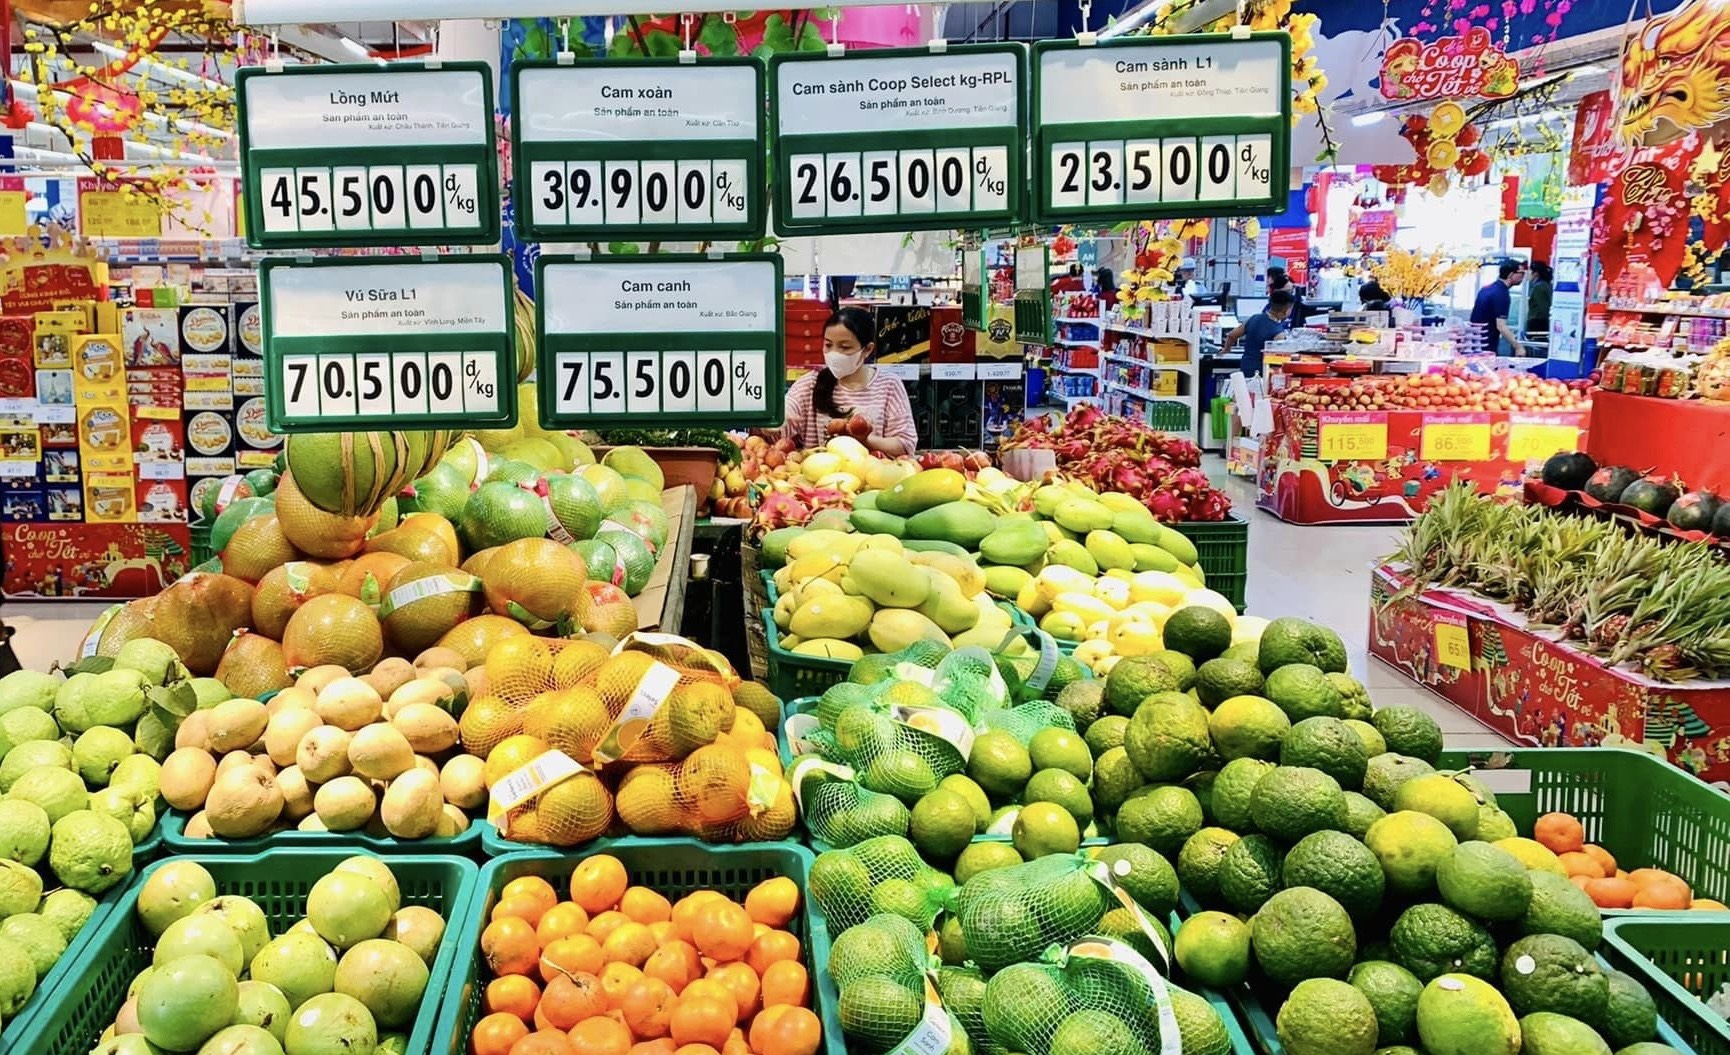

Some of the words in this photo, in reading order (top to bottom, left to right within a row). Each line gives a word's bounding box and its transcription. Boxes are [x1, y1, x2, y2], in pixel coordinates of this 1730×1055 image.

[1115, 60, 1148, 73] Cam
[1152, 57, 1187, 72] sành
[1196, 56, 1213, 69] L1
[792, 82, 825, 97] Cam
[829, 79, 864, 94] sành
[868, 77, 908, 93] Coop
[911, 74, 957, 89] Select
[960, 71, 1013, 88] kg-RPL
[1120, 81, 1139, 92] Sản
[1141, 79, 1168, 92] phẩm
[1185, 78, 1207, 88] toàn
[1403, 72, 1425, 84] chở
[1418, 69, 1469, 96] Tết
[1464, 81, 1482, 95] về
[330, 90, 367, 107] Lồng
[371, 90, 400, 105] Mứt
[601, 86, 633, 99] Cam
[637, 85, 673, 99] xoàn
[594, 107, 612, 117] Sản
[614, 106, 642, 118] phẩm
[644, 109, 656, 117] an
[657, 108, 679, 117] toàn
[860, 100, 879, 111] Sản
[881, 97, 908, 111] phẩm
[910, 100, 922, 108] an
[924, 98, 946, 107] toàn
[372, 114, 385, 122] an
[387, 112, 409, 122] toàn
[1059, 142, 1232, 193] 23.500
[1240, 142, 1271, 184] đ/kg
[796, 155, 965, 205] 26.500
[975, 155, 1006, 196] đ/kg
[269, 172, 437, 218] 45.500
[444, 173, 476, 214] đ/kg
[542, 167, 705, 212] 39.900
[715, 170, 746, 212] đ/kg
[621, 280, 654, 293] Cam
[657, 279, 691, 293] canh
[345, 289, 364, 302] Vú
[368, 288, 397, 301] Sữa
[401, 288, 417, 300] L1
[614, 300, 633, 310] Sản
[635, 299, 661, 311] phẩm
[663, 301, 675, 309] an
[677, 300, 698, 309] toàn
[341, 311, 360, 320] Sản
[362, 308, 388, 320] phẩm
[390, 310, 402, 318] an
[404, 308, 425, 318] toàn
[287, 360, 454, 403] 70.500
[465, 359, 495, 398] đ/kg
[561, 357, 726, 402] 75.500
[734, 360, 763, 400] đ/kg
